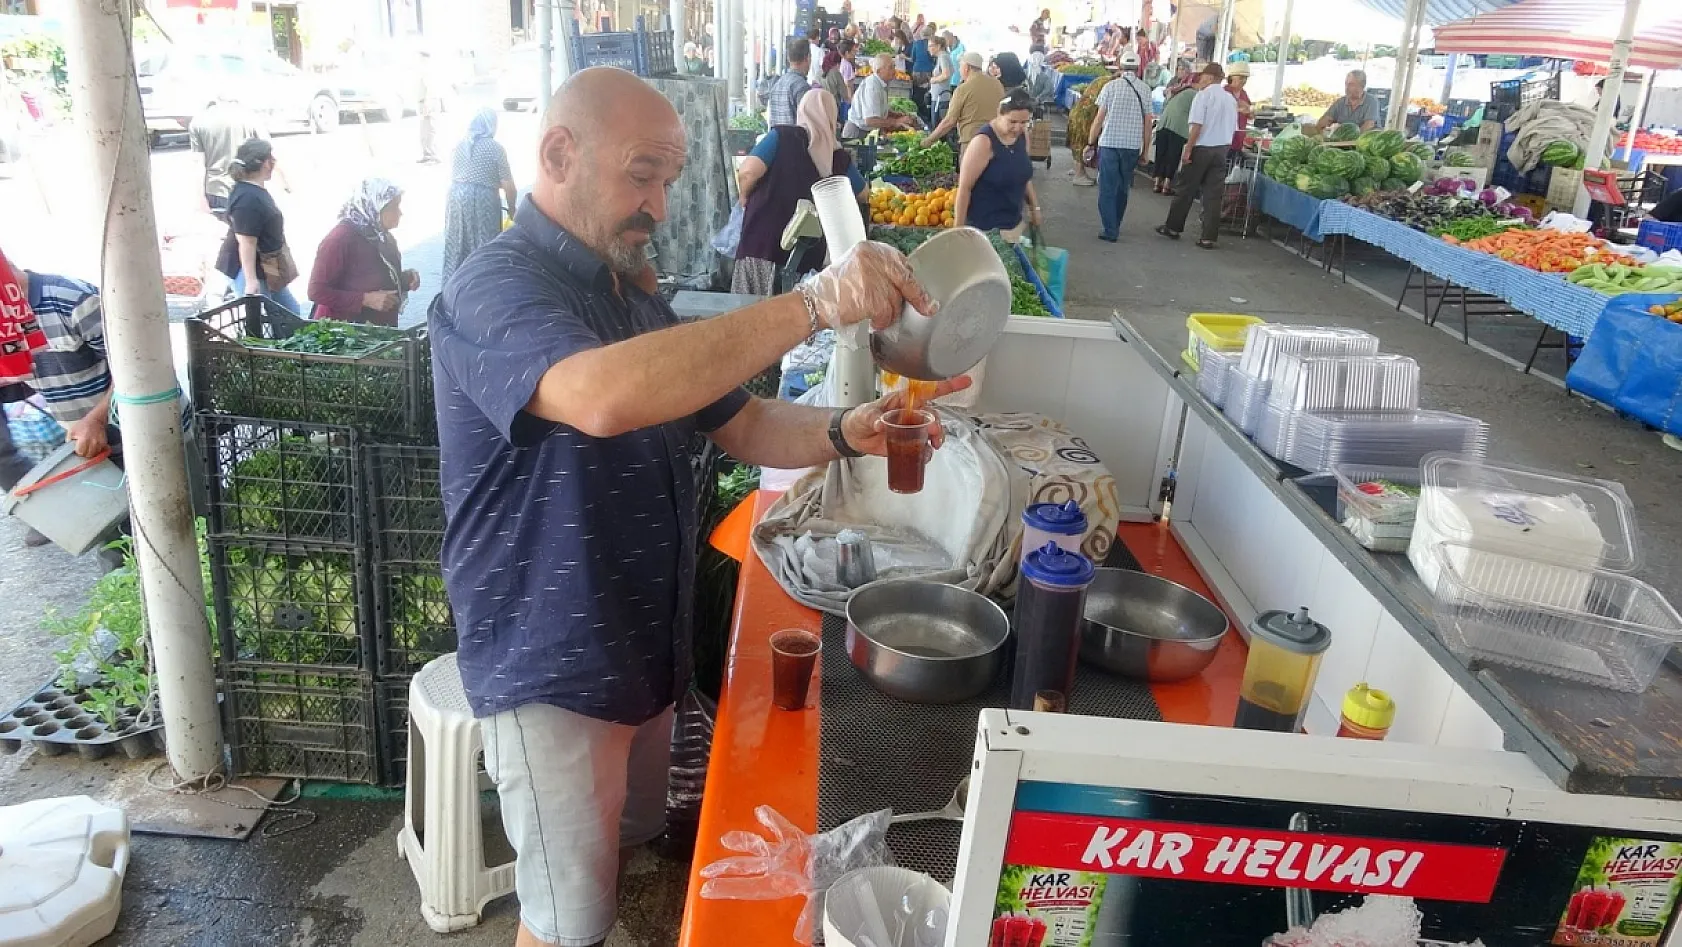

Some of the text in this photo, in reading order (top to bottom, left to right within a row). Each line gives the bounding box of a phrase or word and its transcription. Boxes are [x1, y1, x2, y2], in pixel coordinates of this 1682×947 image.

[1081, 826, 1424, 888] KAR HELVASI
[1615, 844, 1660, 859] KAR
[1030, 873, 1070, 886] KAR
